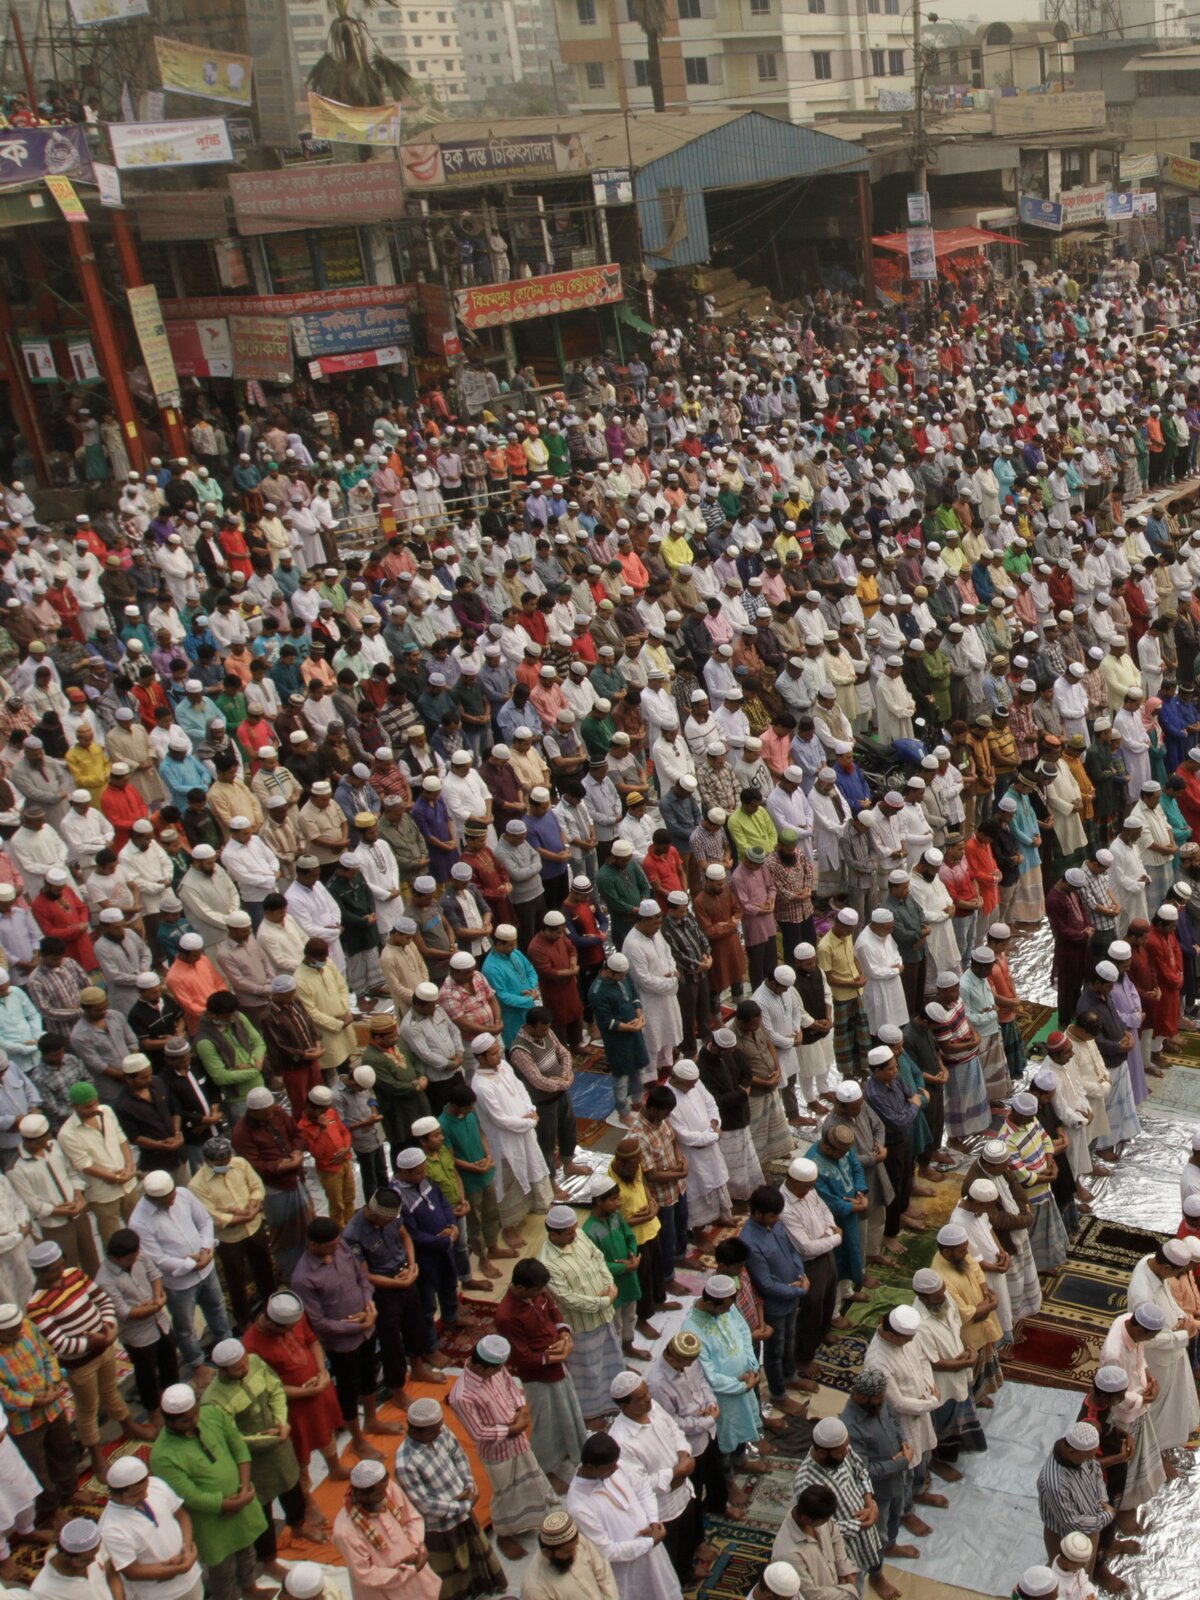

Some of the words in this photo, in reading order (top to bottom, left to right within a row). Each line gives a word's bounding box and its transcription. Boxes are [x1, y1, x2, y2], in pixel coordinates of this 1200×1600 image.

[441, 149, 464, 172] হক
[465, 147, 487, 168] দন্ত
[488, 136, 553, 166] চিকিৎসালয়
